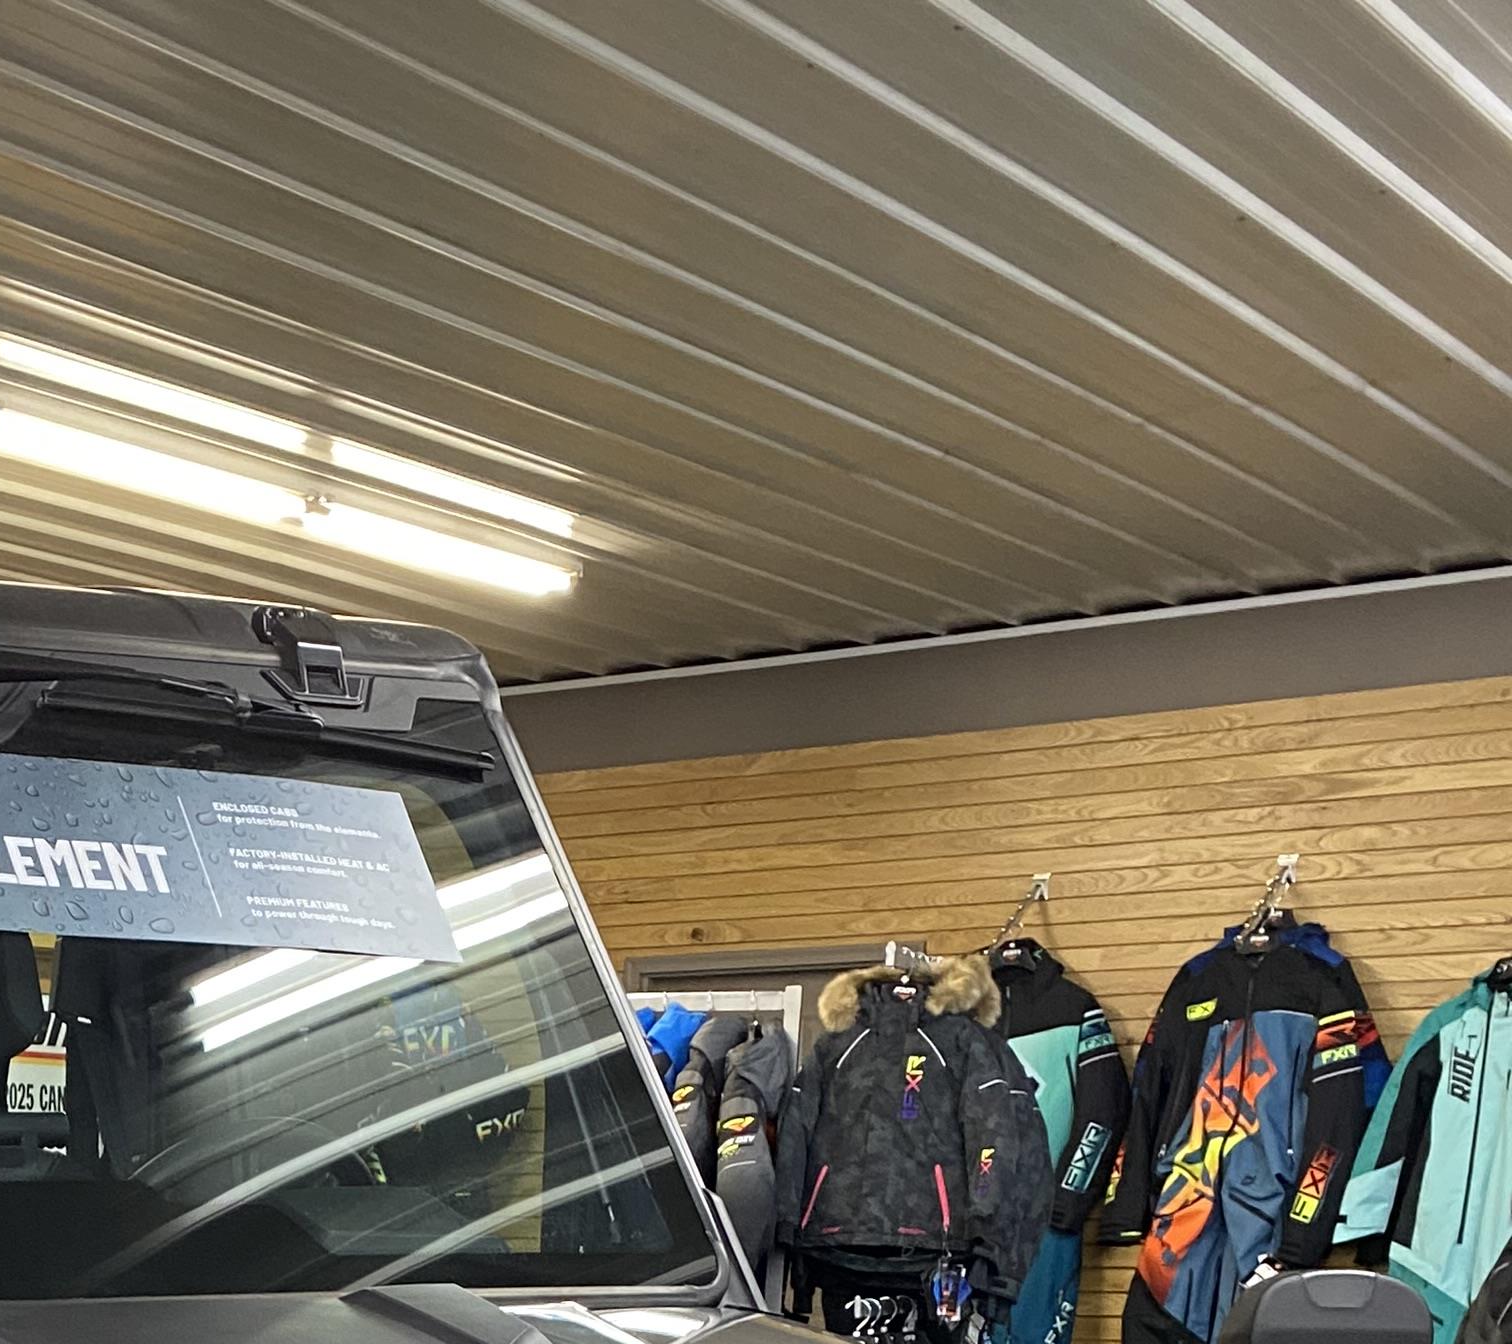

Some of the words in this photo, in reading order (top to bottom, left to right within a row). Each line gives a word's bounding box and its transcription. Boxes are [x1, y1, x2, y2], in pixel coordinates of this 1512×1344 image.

[212, 801, 269, 815] ENCLOSED
[216, 813, 233, 824] for
[235, 816, 289, 828] protection
[290, 819, 315, 832] from
[229, 847, 337, 866] FACTORY-INSTALLED
[337, 856, 364, 869] HEAT
[376, 863, 390, 872] AC
[233, 860, 249, 870] for
[251, 862, 305, 873] all-season
[246, 896, 294, 908] PREMIUM
[296, 898, 350, 912] FEATURES
[251, 908, 264, 918] to
[265, 910, 297, 920] power
[299, 910, 340, 923] through
[7, 1083, 34, 1111] 025
